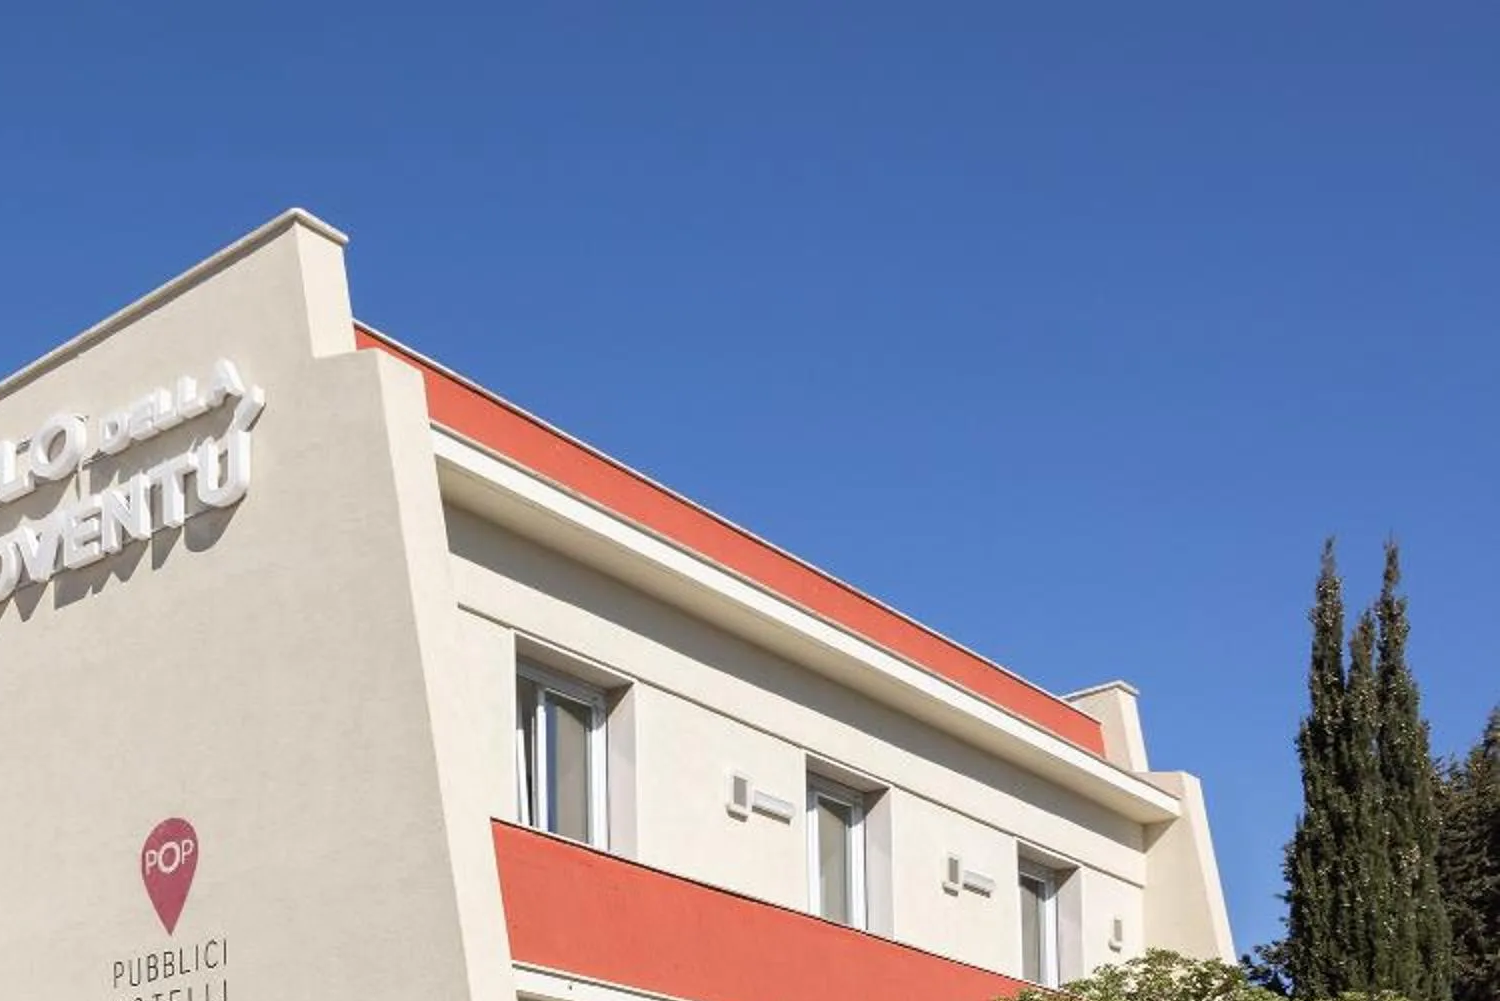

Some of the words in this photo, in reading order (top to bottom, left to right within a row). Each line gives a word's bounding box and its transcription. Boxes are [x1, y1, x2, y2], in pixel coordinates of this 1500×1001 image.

[100, 359, 245, 455] DELLA
[145, 839, 195, 875] POP
[113, 939, 228, 989] PUBBLICI
